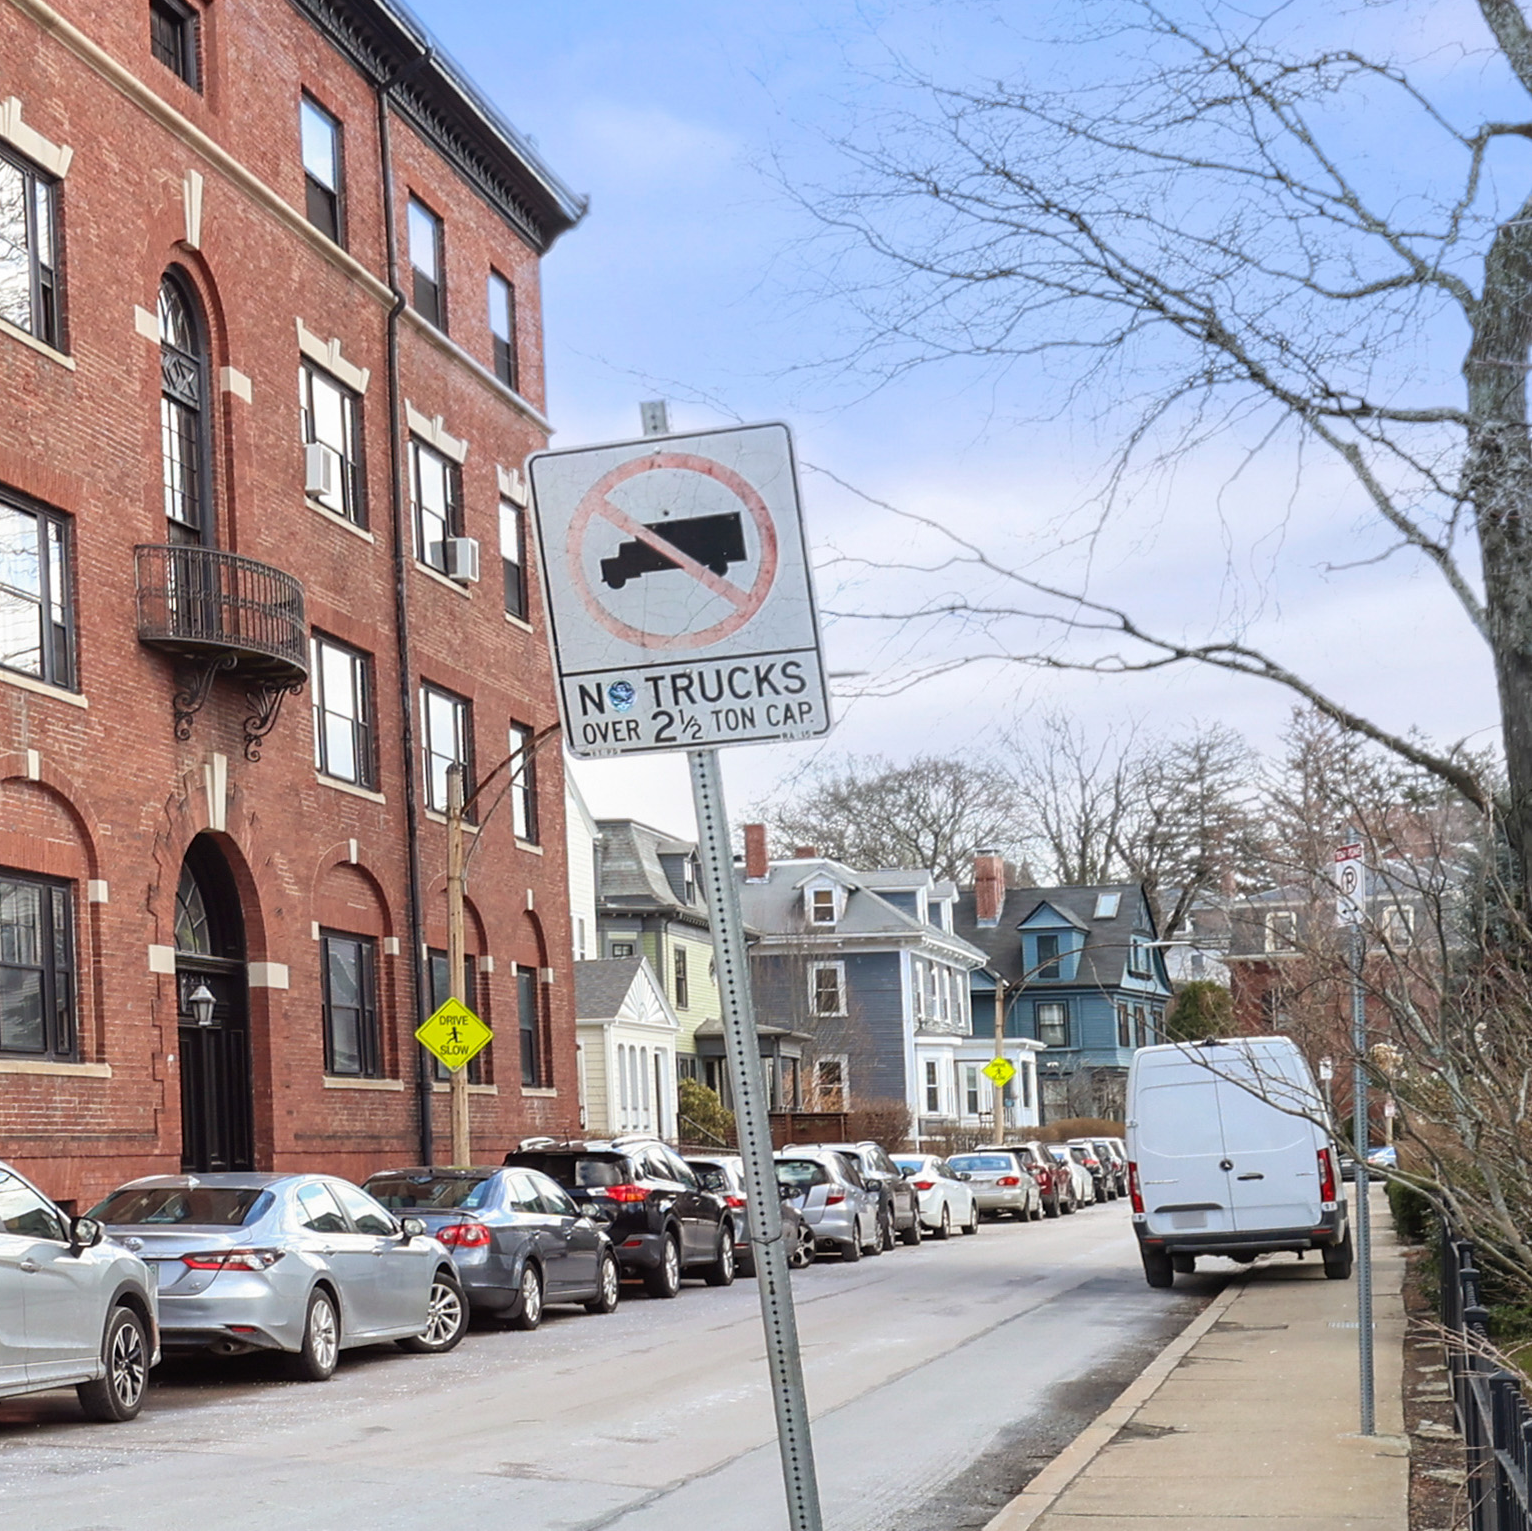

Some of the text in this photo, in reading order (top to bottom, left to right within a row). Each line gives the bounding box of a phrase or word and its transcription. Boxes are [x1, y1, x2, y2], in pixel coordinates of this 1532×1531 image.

[644, 661, 807, 709] TRUCKS
[583, 719, 641, 745] OVER
[711, 707, 756, 733] TON
[766, 701, 815, 727] CAP.
[439, 1015, 469, 1026] DRIVE
[440, 1045, 470, 1056] SLOW
